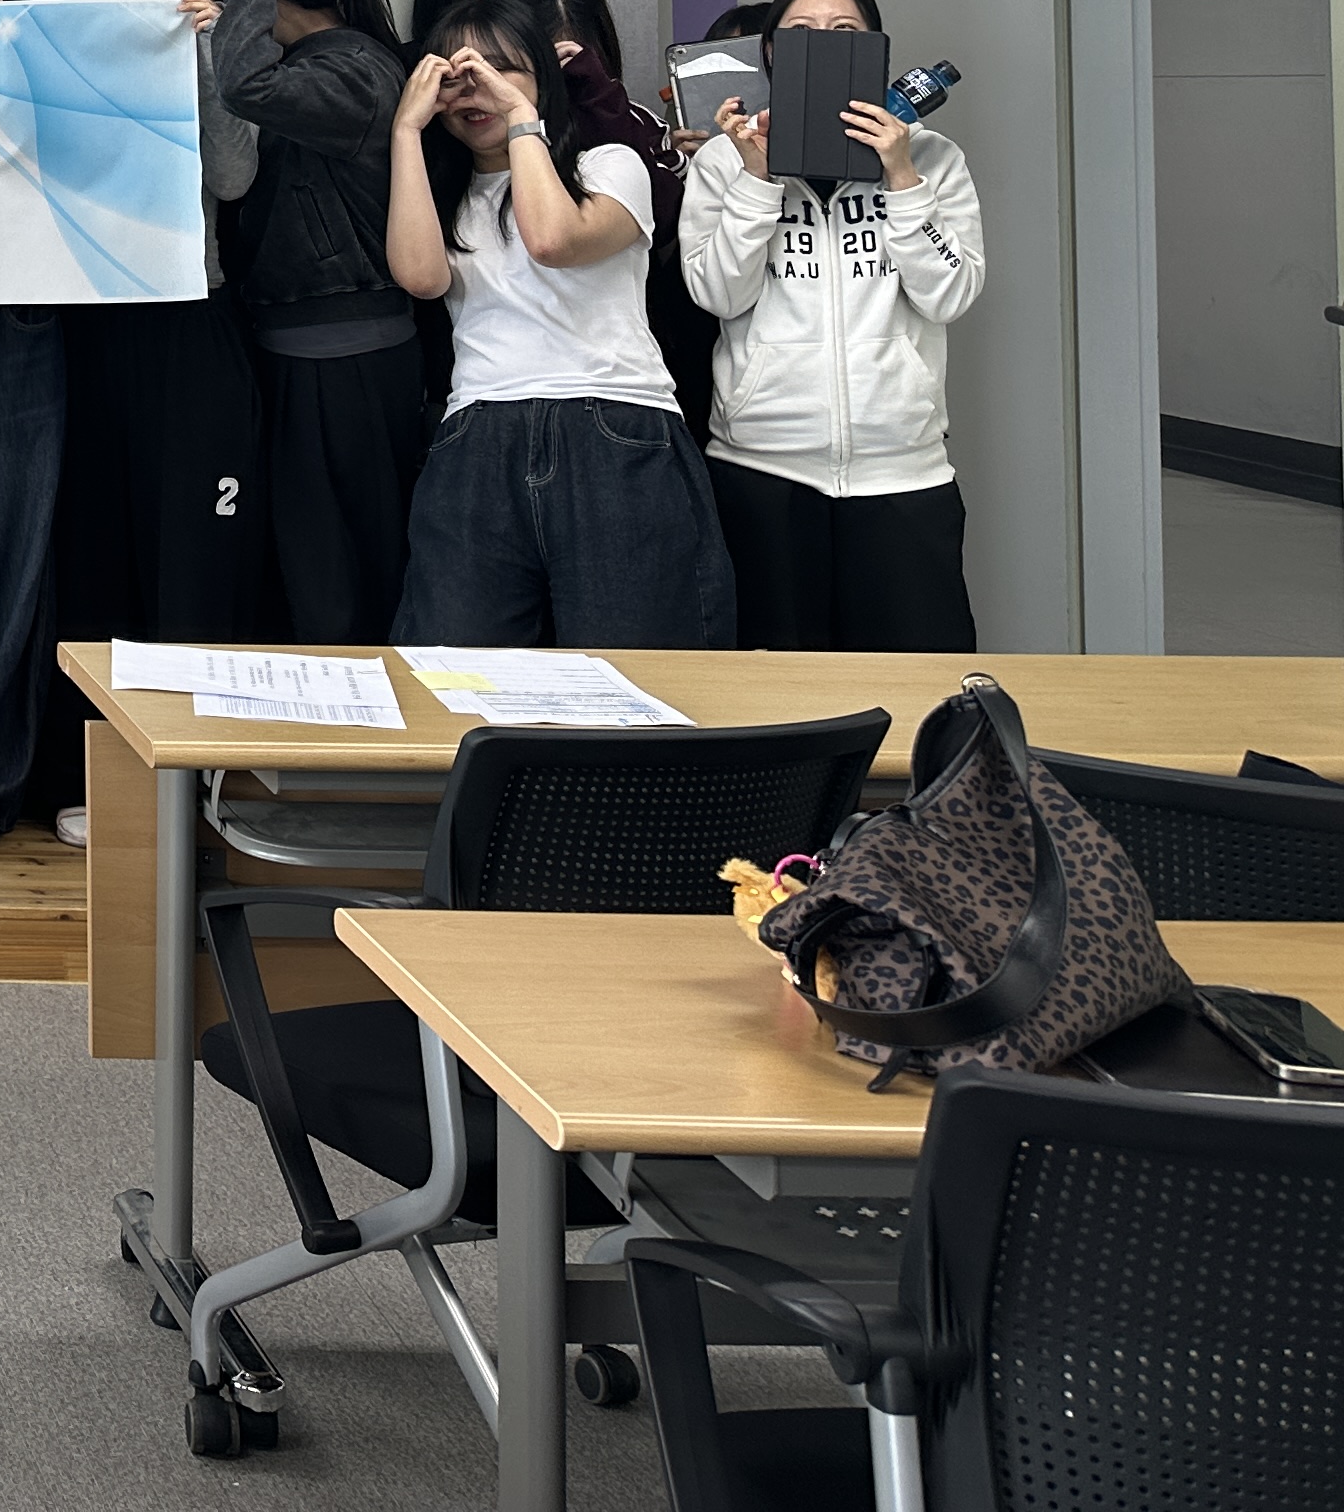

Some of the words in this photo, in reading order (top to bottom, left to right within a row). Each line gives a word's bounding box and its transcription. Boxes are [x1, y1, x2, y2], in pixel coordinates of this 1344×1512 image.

[783, 230, 813, 255] 19
[843, 230, 877, 255] 20
[937, 242, 961, 269] SAN
[216, 477, 239, 516] 2
